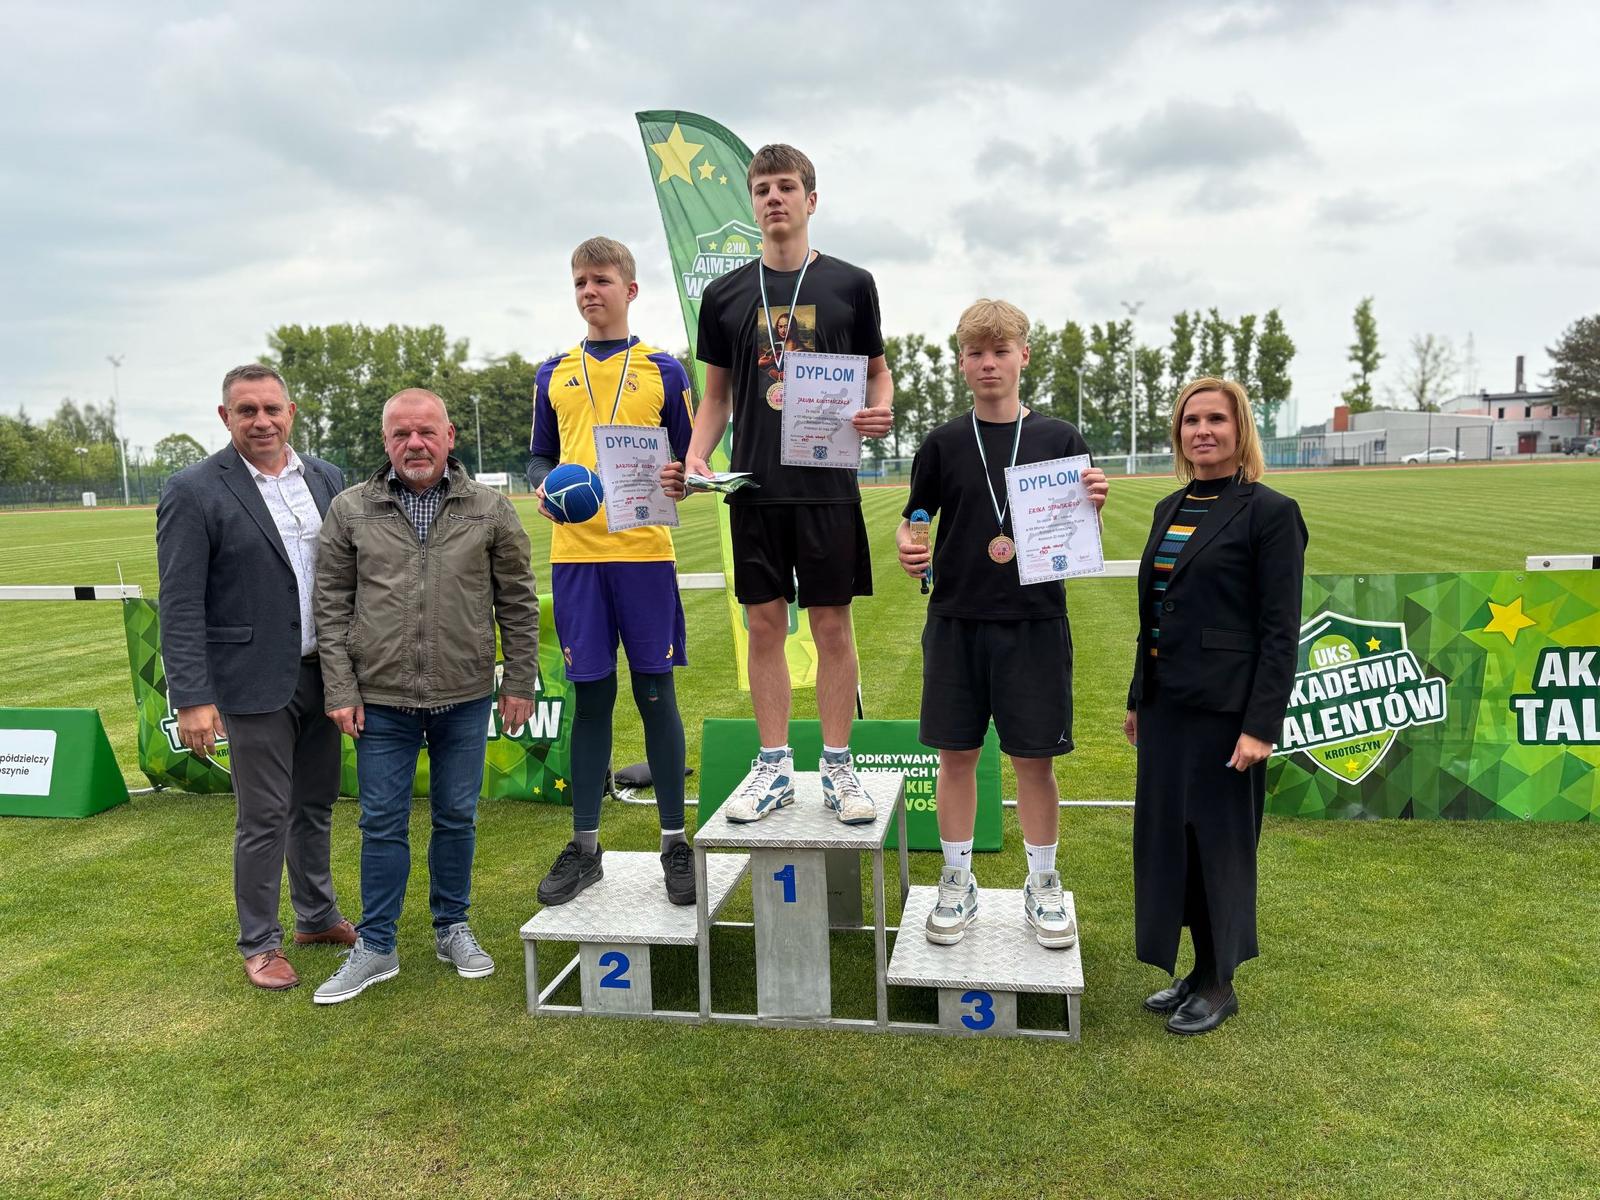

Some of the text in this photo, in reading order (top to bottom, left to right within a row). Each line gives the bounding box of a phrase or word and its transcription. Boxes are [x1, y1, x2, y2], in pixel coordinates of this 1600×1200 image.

[796, 365, 854, 382] DYPLOM
[605, 436, 658, 450] DYPLOM
[1018, 469, 1080, 492] DYPLOM
[1314, 643, 1351, 666] UKS
[1538, 651, 1600, 687] AK
[1287, 656, 1418, 708] KADEMIA
[1273, 684, 1441, 749] ALENTÓW
[856, 754, 940, 764] ODKRYWAMY
[1324, 740, 1381, 760] KROTOSZYN
[0, 766, 30, 778] szynie
[773, 864, 797, 903] 1
[599, 951, 631, 989] 2
[961, 991, 996, 1031] 3
